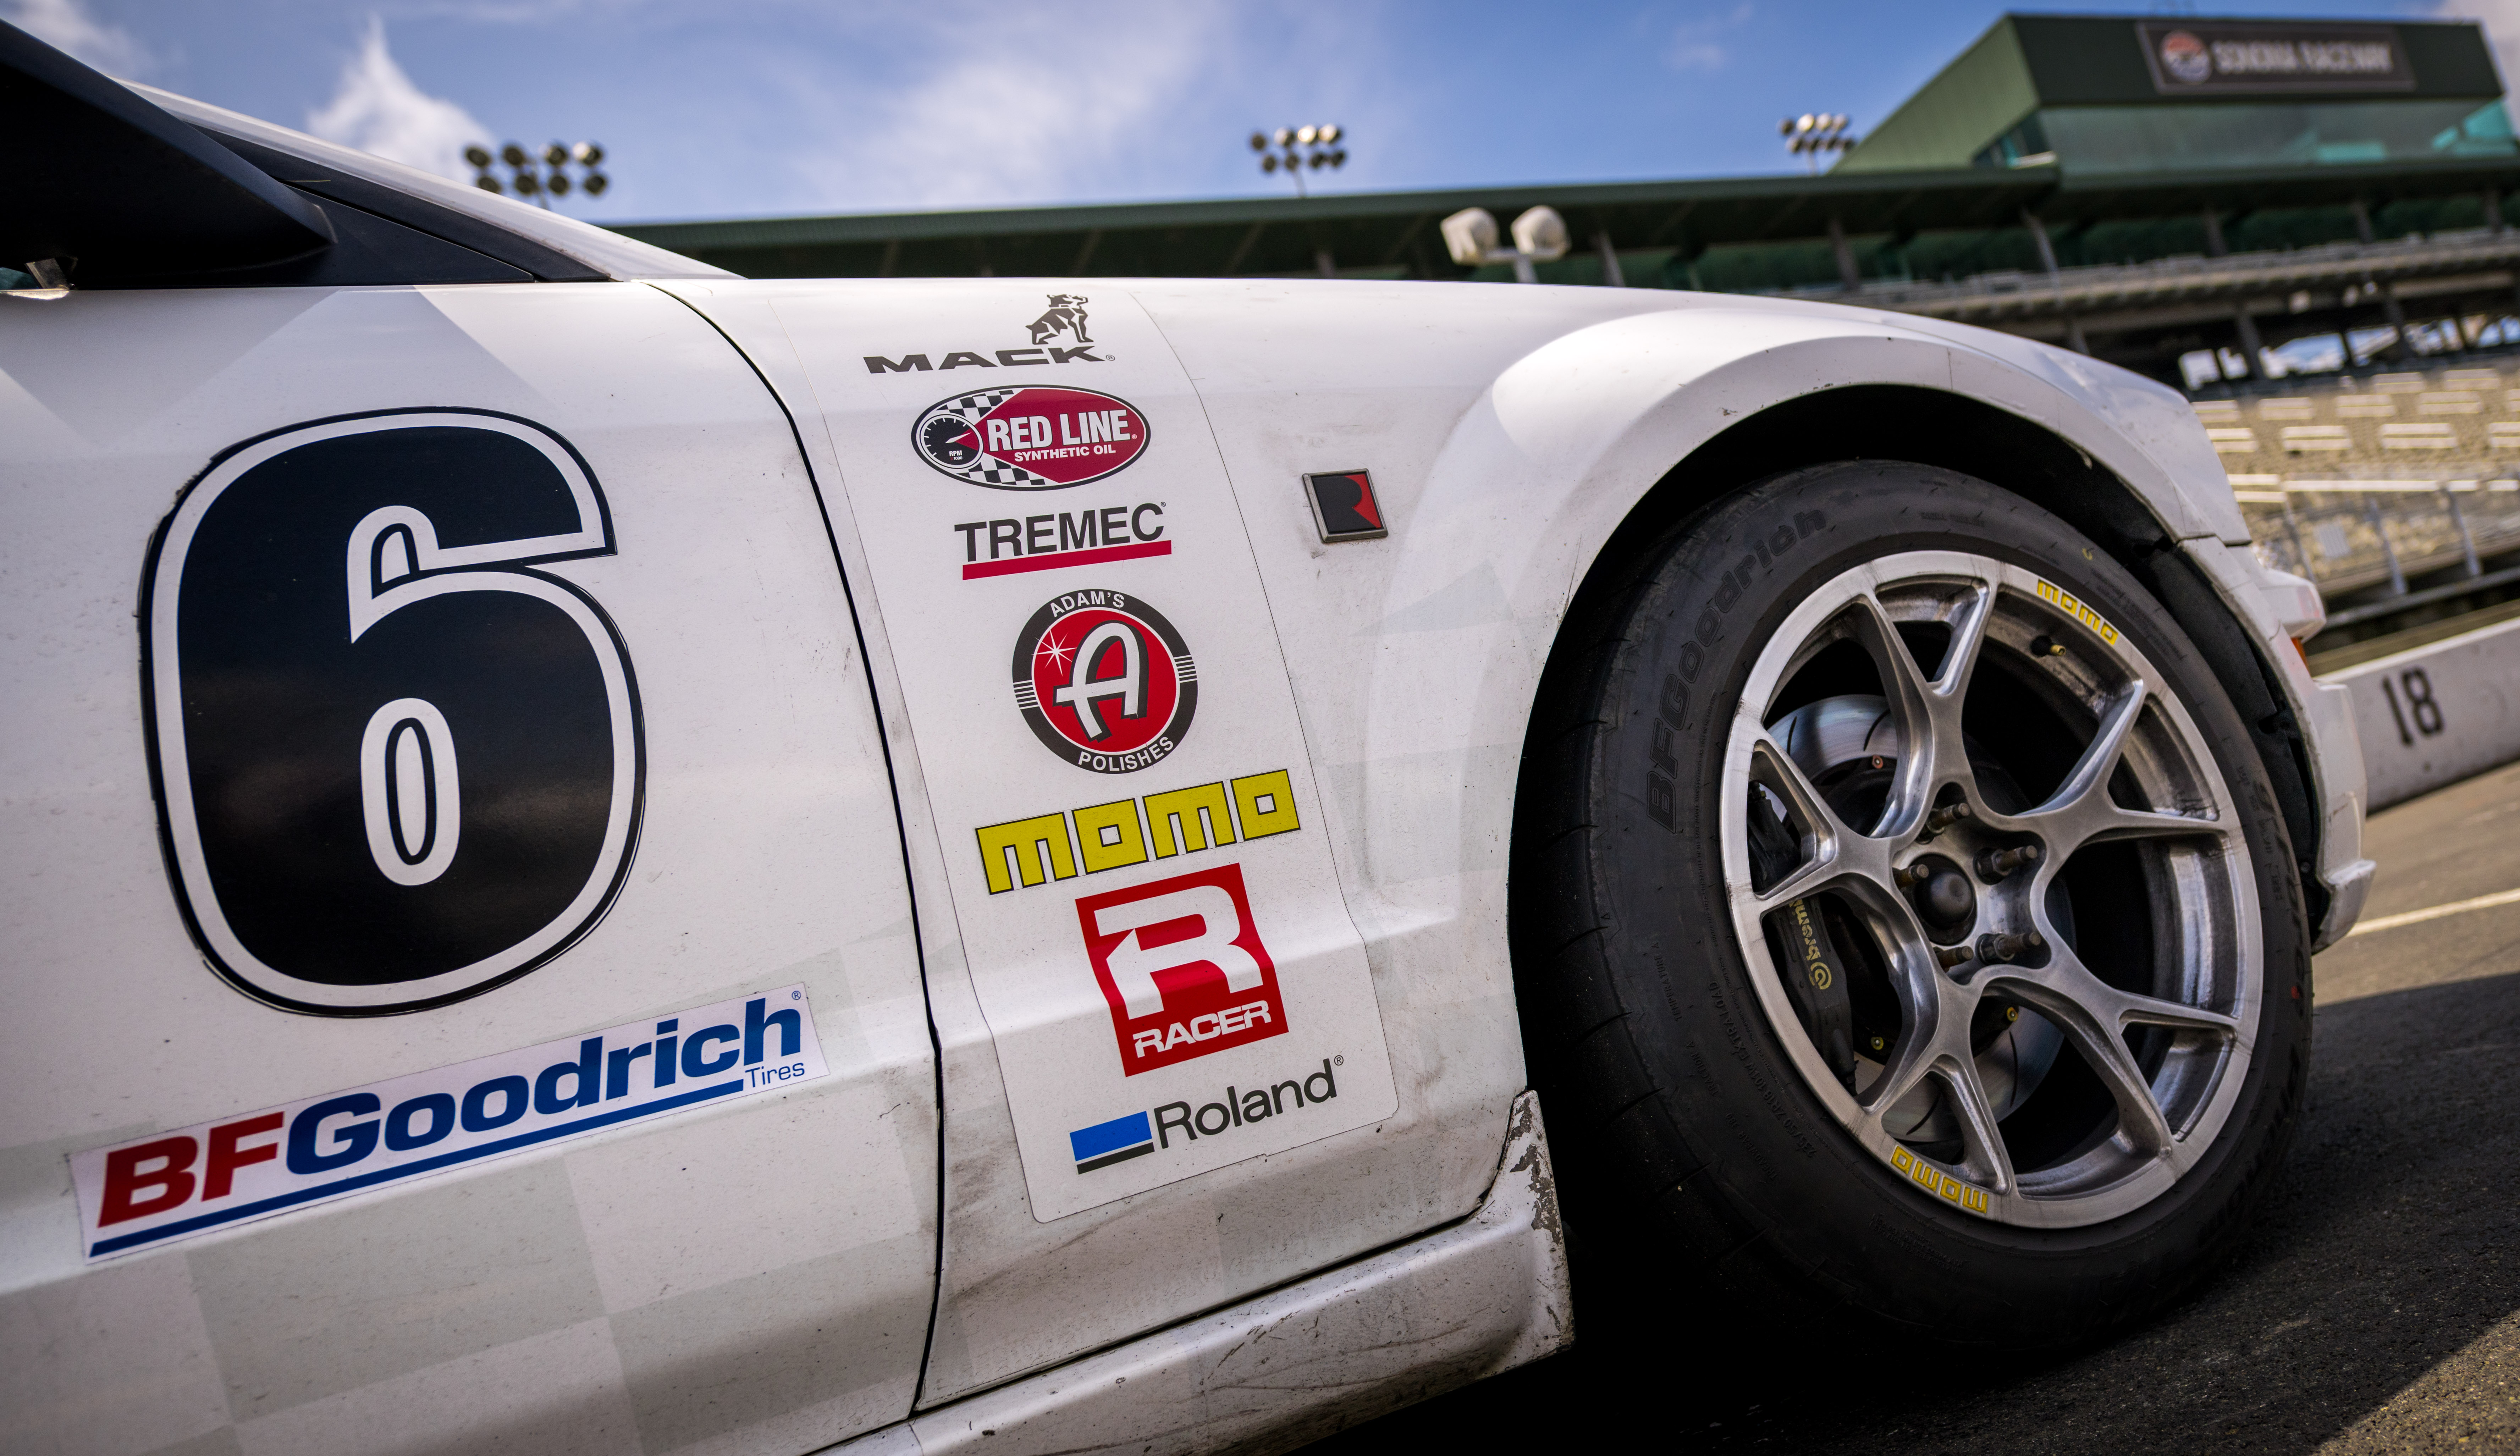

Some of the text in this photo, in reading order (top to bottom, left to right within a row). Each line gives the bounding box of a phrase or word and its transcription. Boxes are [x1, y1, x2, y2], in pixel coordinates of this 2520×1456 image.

[863, 346, 1105, 373] MACK
[987, 409, 1131, 452] RED LINE
[1014, 444, 1116, 462] SYNTHETIC OIL
[954, 503, 1164, 562] TREMEC
[1050, 591, 1124, 618] ADAM'S
[2037, 579, 2119, 645] momo
[1057, 623, 1139, 738] A
[1647, 509, 1826, 833] BFGoodrich
[138, 406, 646, 1017] 6
[2382, 666, 2444, 746] 18
[1078, 737, 1174, 771] POLISHES
[975, 768, 1301, 895] momo
[1705, 979, 1730, 1017] LOAD
[1133, 1000, 1272, 1059] RACER
[1721, 1016, 1750, 1061] EXTRA
[98, 997, 805, 1228] BFGoodrich Tires
[1154, 1058, 1338, 1149] Roland
[1891, 1146, 1988, 1214] momo
